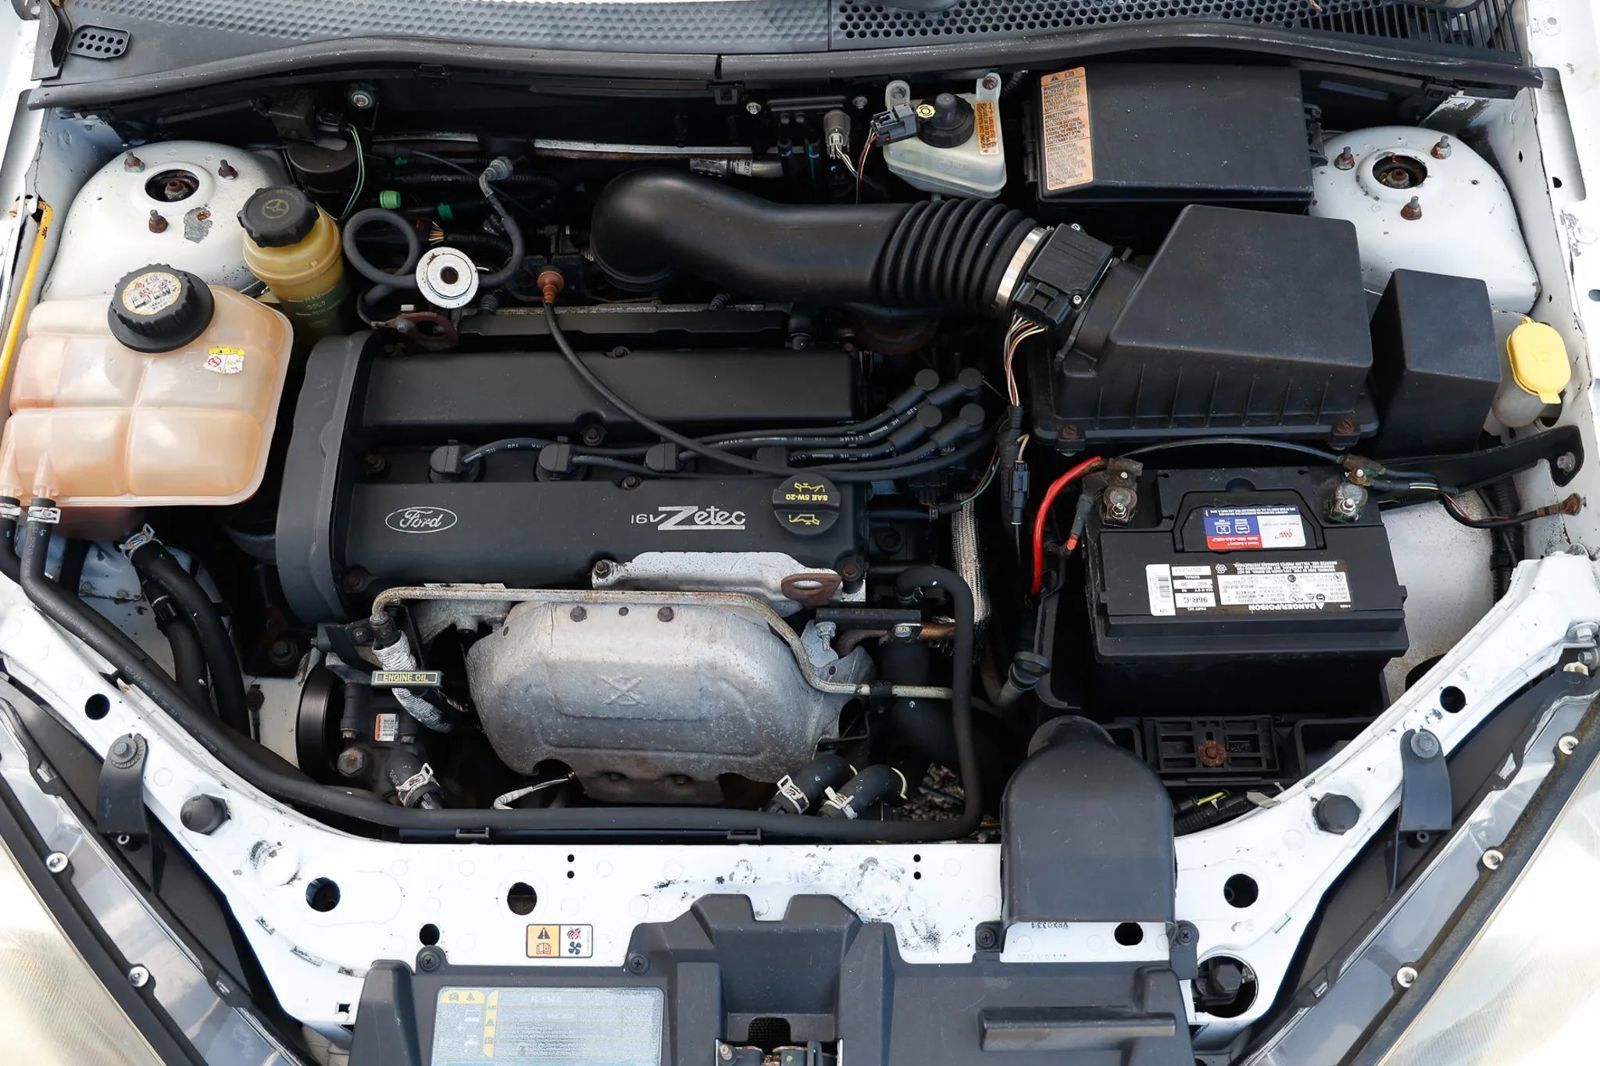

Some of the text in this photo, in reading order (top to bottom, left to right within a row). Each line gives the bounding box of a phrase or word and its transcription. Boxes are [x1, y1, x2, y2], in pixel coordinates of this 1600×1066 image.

[785, 493, 810, 501] 5W-20
[399, 509, 443, 530] Ford
[631, 506, 747, 531] 16V Zetec
[1248, 602, 1316, 611] DANGER/POISON
[383, 673, 429, 682] ENGINE OIL
